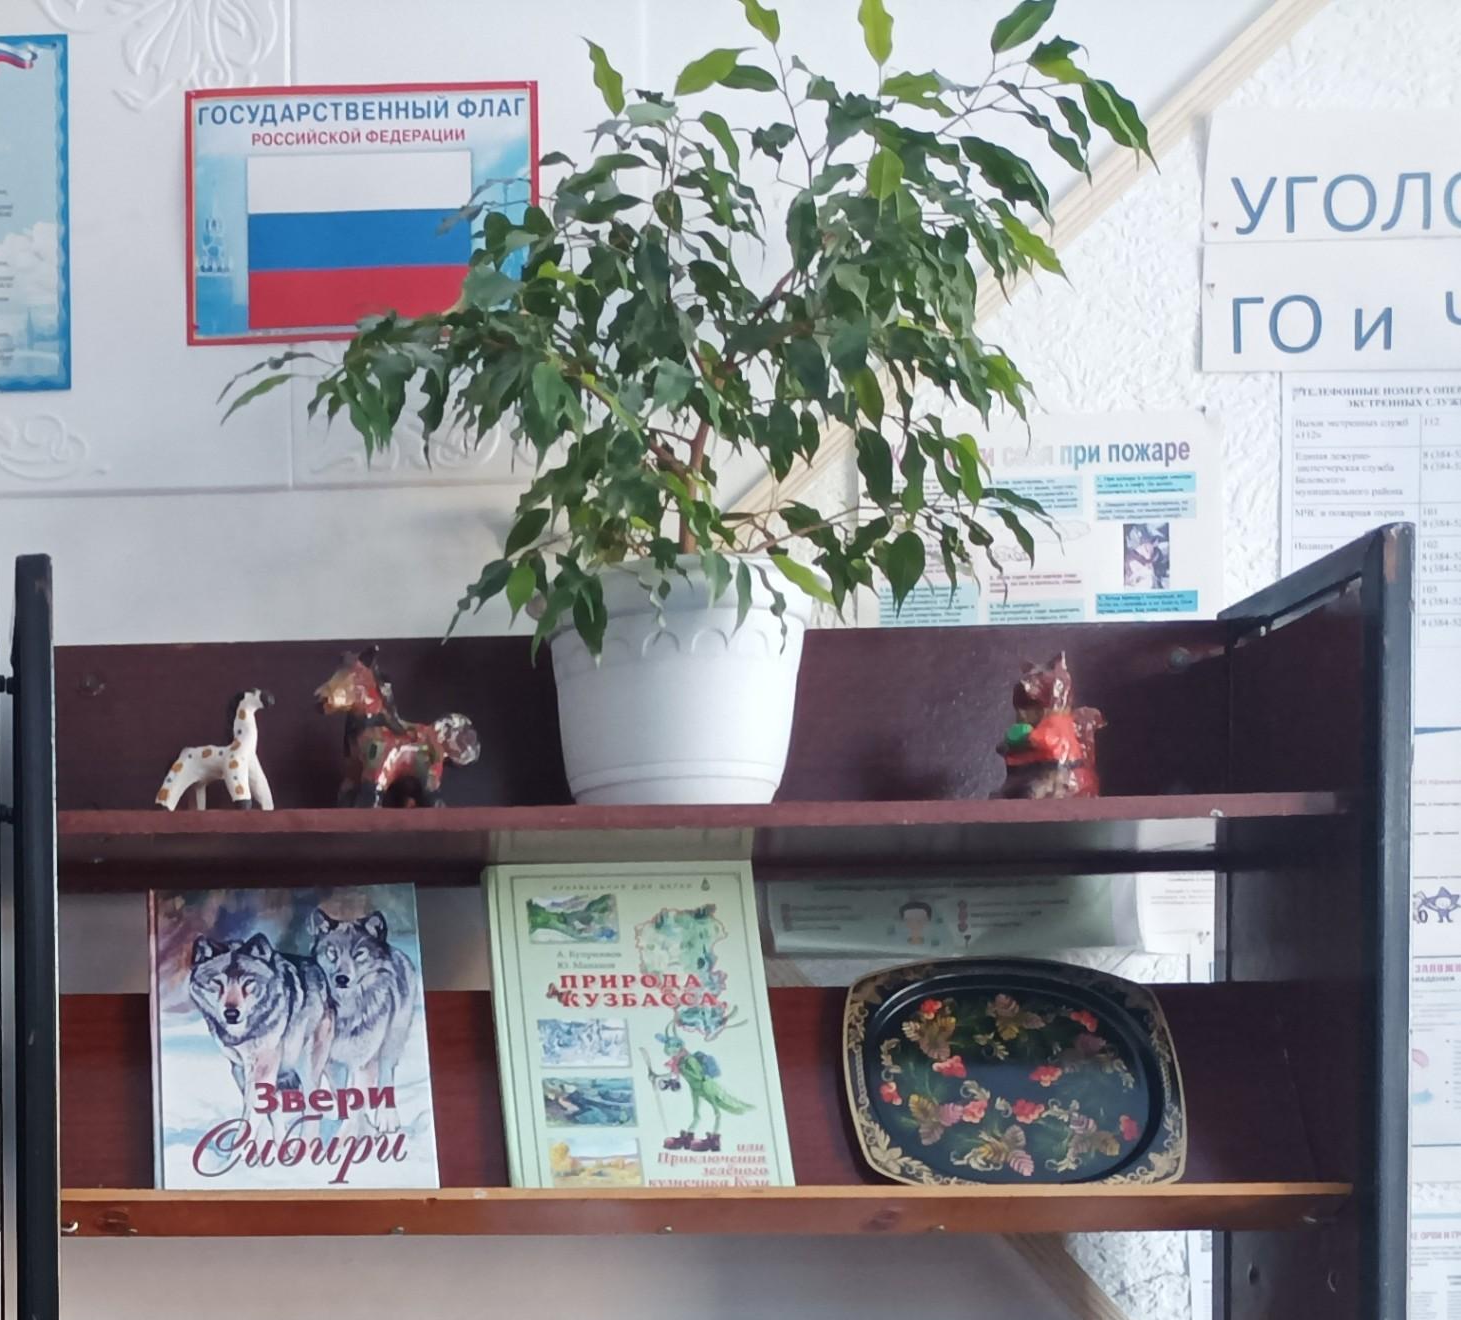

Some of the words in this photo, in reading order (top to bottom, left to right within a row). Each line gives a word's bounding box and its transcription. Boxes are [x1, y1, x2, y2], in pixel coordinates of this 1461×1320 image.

[197, 95, 450, 127] ГОСУДАРСТВЕННЫЙ
[456, 96, 525, 119] ФЛАГ
[251, 127, 362, 147] РОССИЙСКОЙ
[365, 127, 466, 145] ФЕДЕРАЦИИ
[1231, 294, 1323, 356] ГО
[1354, 306, 1394, 351] и
[1059, 443, 1101, 471] при
[1107, 441, 1191, 468] пожаре
[560, 973, 702, 992] ПРИРОДА
[254, 1082, 397, 1119] Звери
[192, 1114, 409, 1185] Сибири
